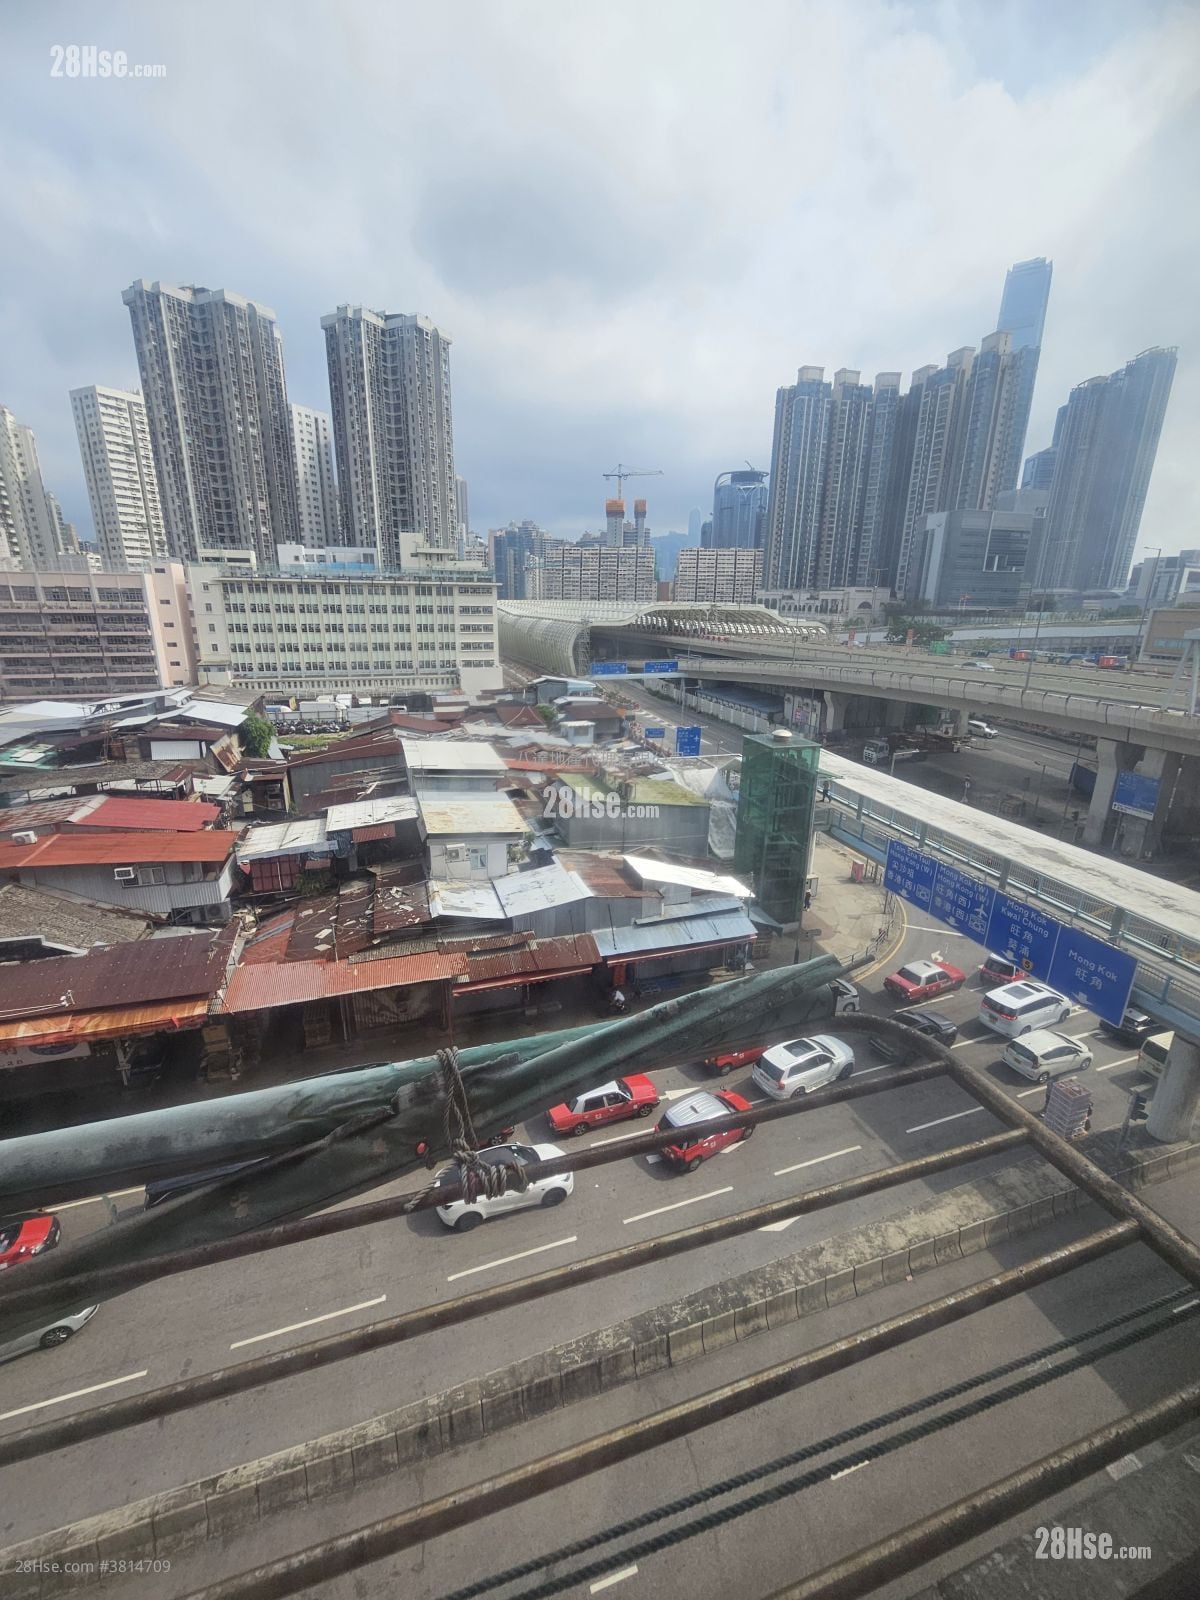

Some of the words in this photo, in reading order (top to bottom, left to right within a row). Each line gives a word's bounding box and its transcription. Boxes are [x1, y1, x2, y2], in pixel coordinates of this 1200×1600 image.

[940, 866, 958, 882] Mong
[1001, 907, 1020, 921] Kwai
[1022, 917, 1049, 938] Chung
[1007, 900, 1029, 918] Mong
[1031, 911, 1048, 926] Kok
[1010, 923, 1033, 943] 旺角
[1068, 949, 1096, 971] Mong
[1098, 964, 1119, 982] Kok
[1075, 967, 1103, 990] 旺角
